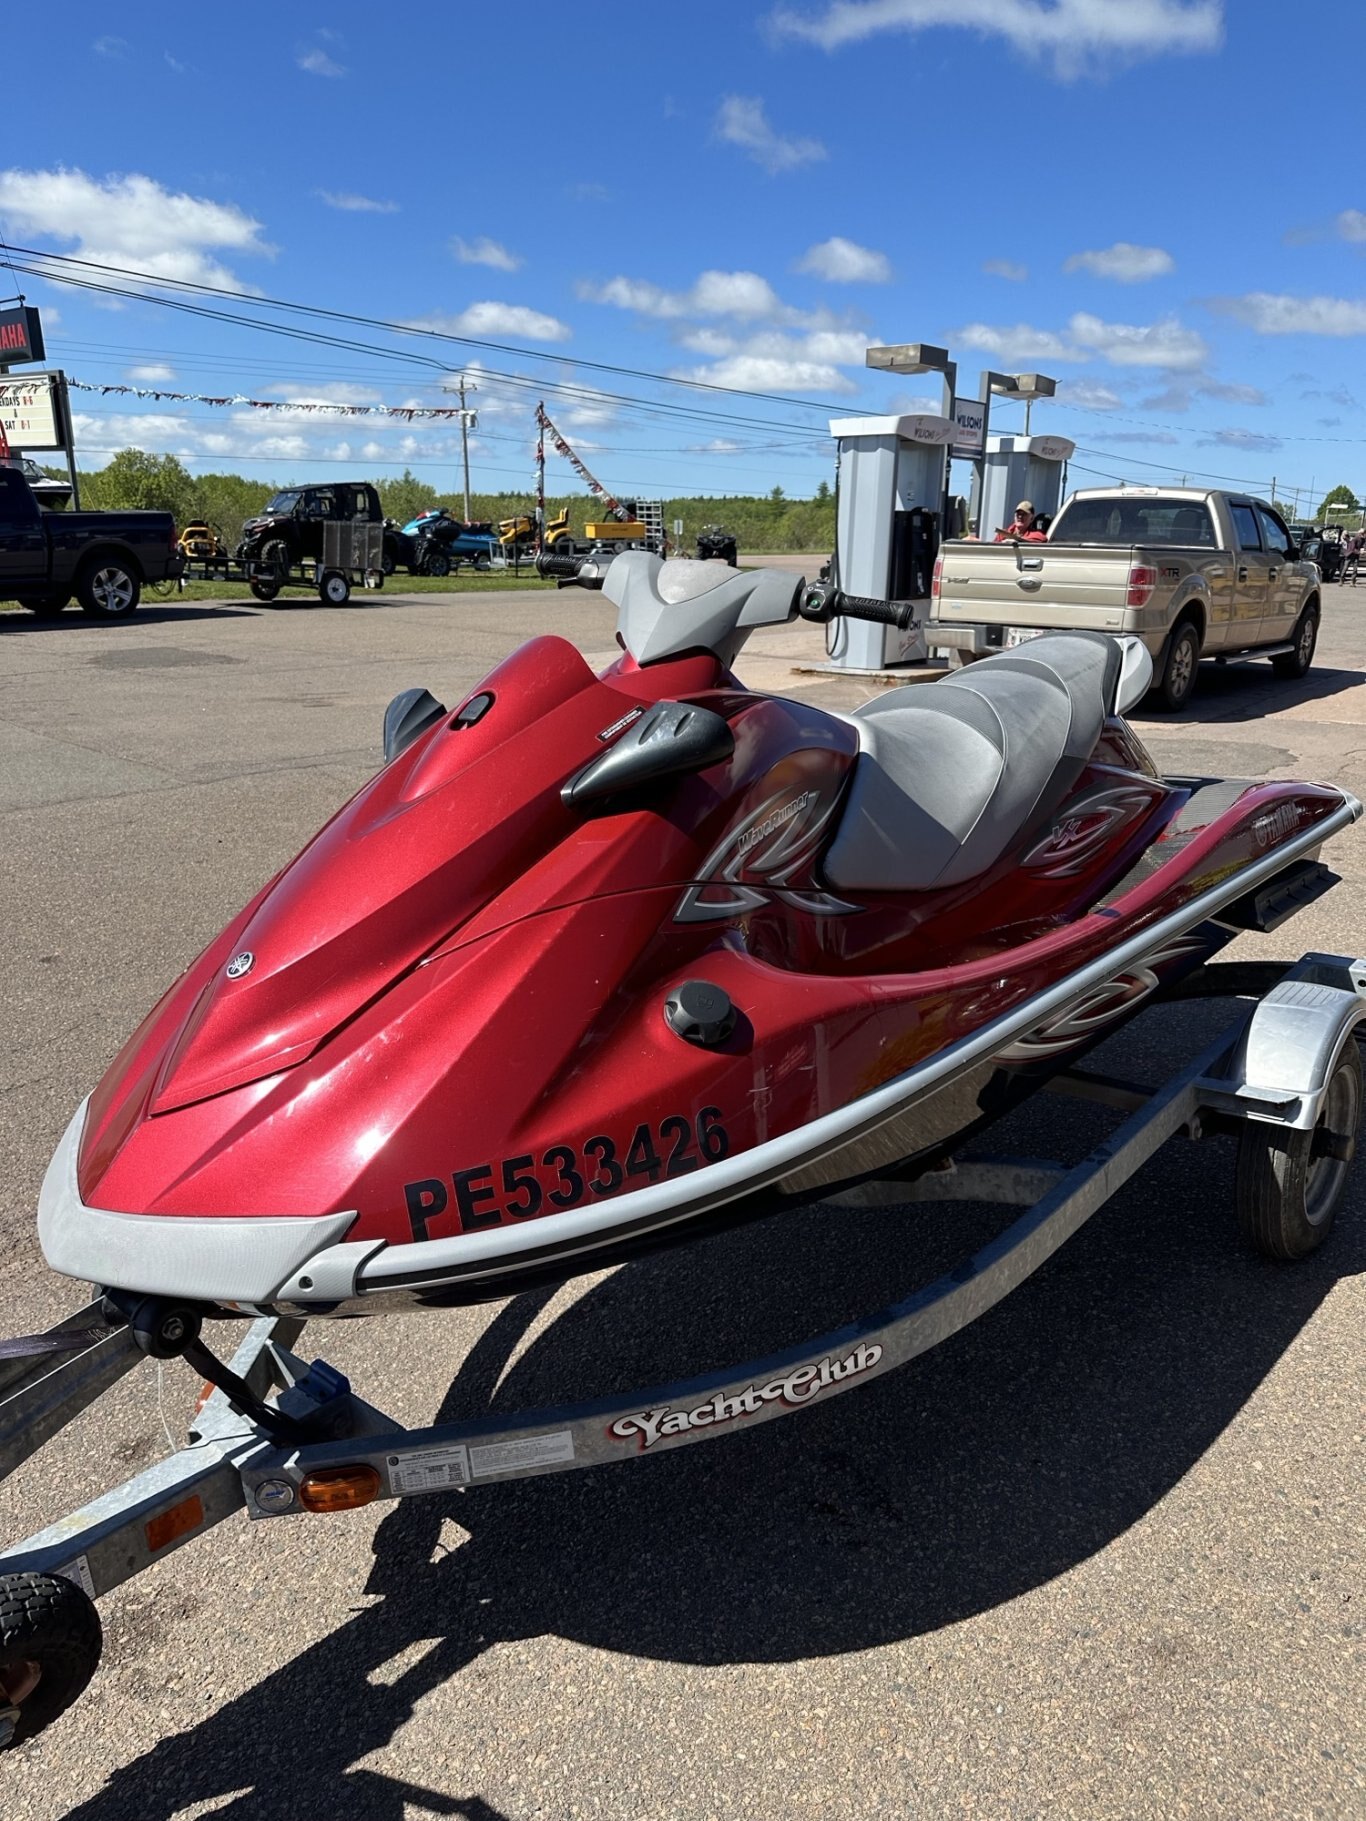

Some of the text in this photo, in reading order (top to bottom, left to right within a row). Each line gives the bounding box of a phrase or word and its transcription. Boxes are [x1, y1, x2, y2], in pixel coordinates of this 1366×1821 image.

[5, 420, 15, 430] SAT
[957, 414, 982, 430] WILSONS
[1160, 567, 1180, 578] XTR
[738, 791, 808, 857] WaveRunner
[403, 1105, 729, 1244] PE533426
